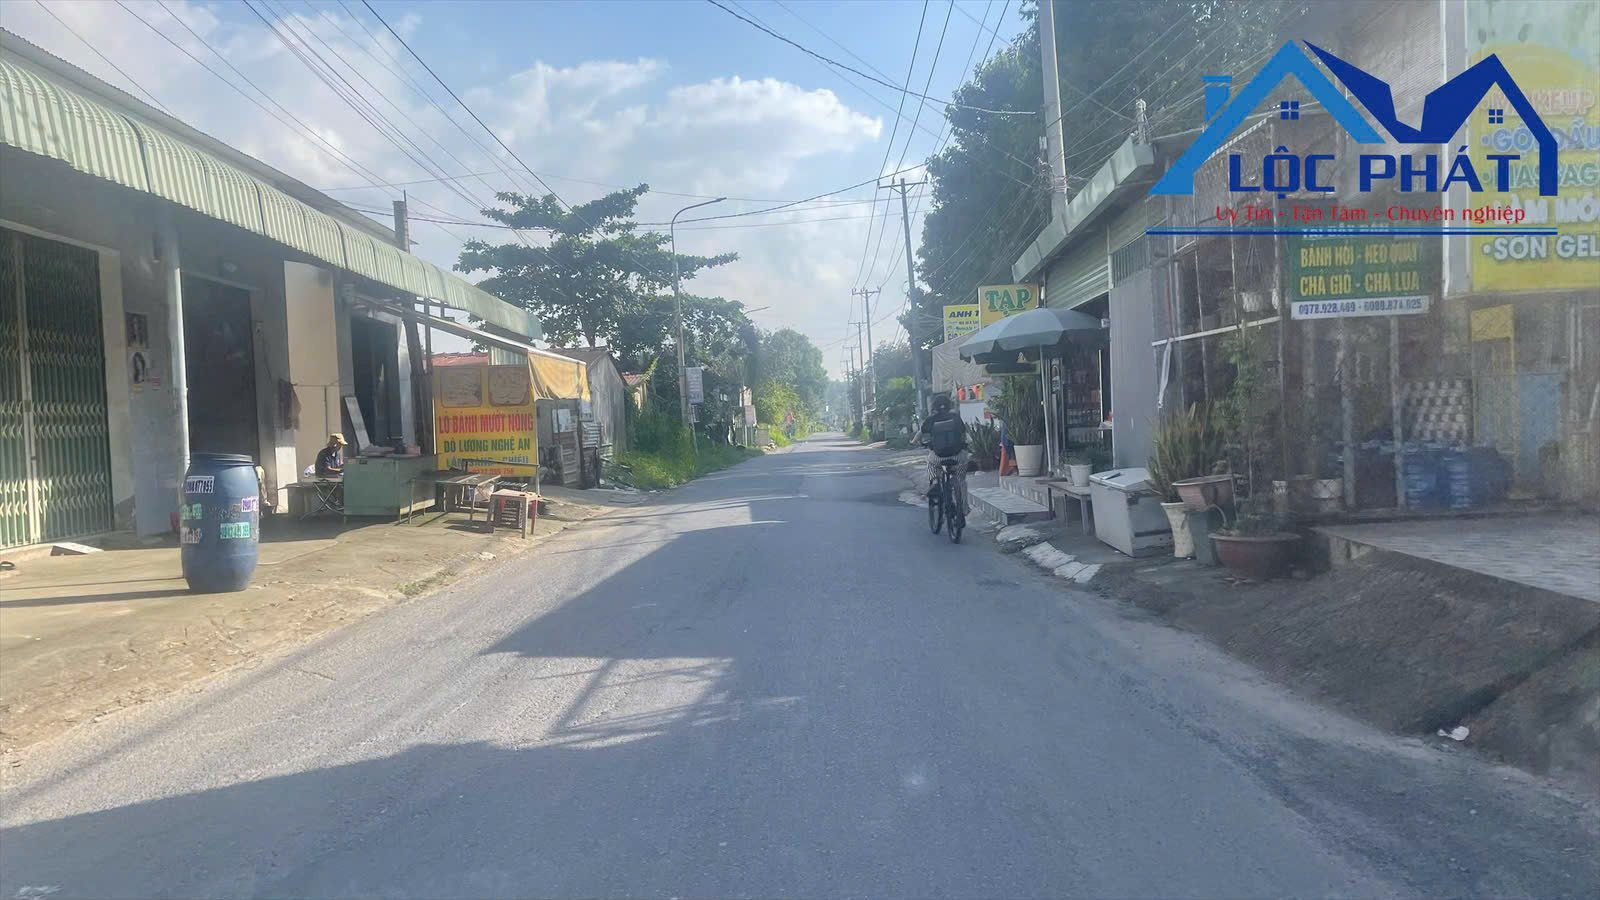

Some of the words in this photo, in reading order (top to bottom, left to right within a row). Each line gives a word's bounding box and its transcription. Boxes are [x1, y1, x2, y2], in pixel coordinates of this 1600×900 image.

[1556, 234, 1600, 258] GEL
[949, 309, 973, 318] ANH
[518, 438, 530, 450] AN
